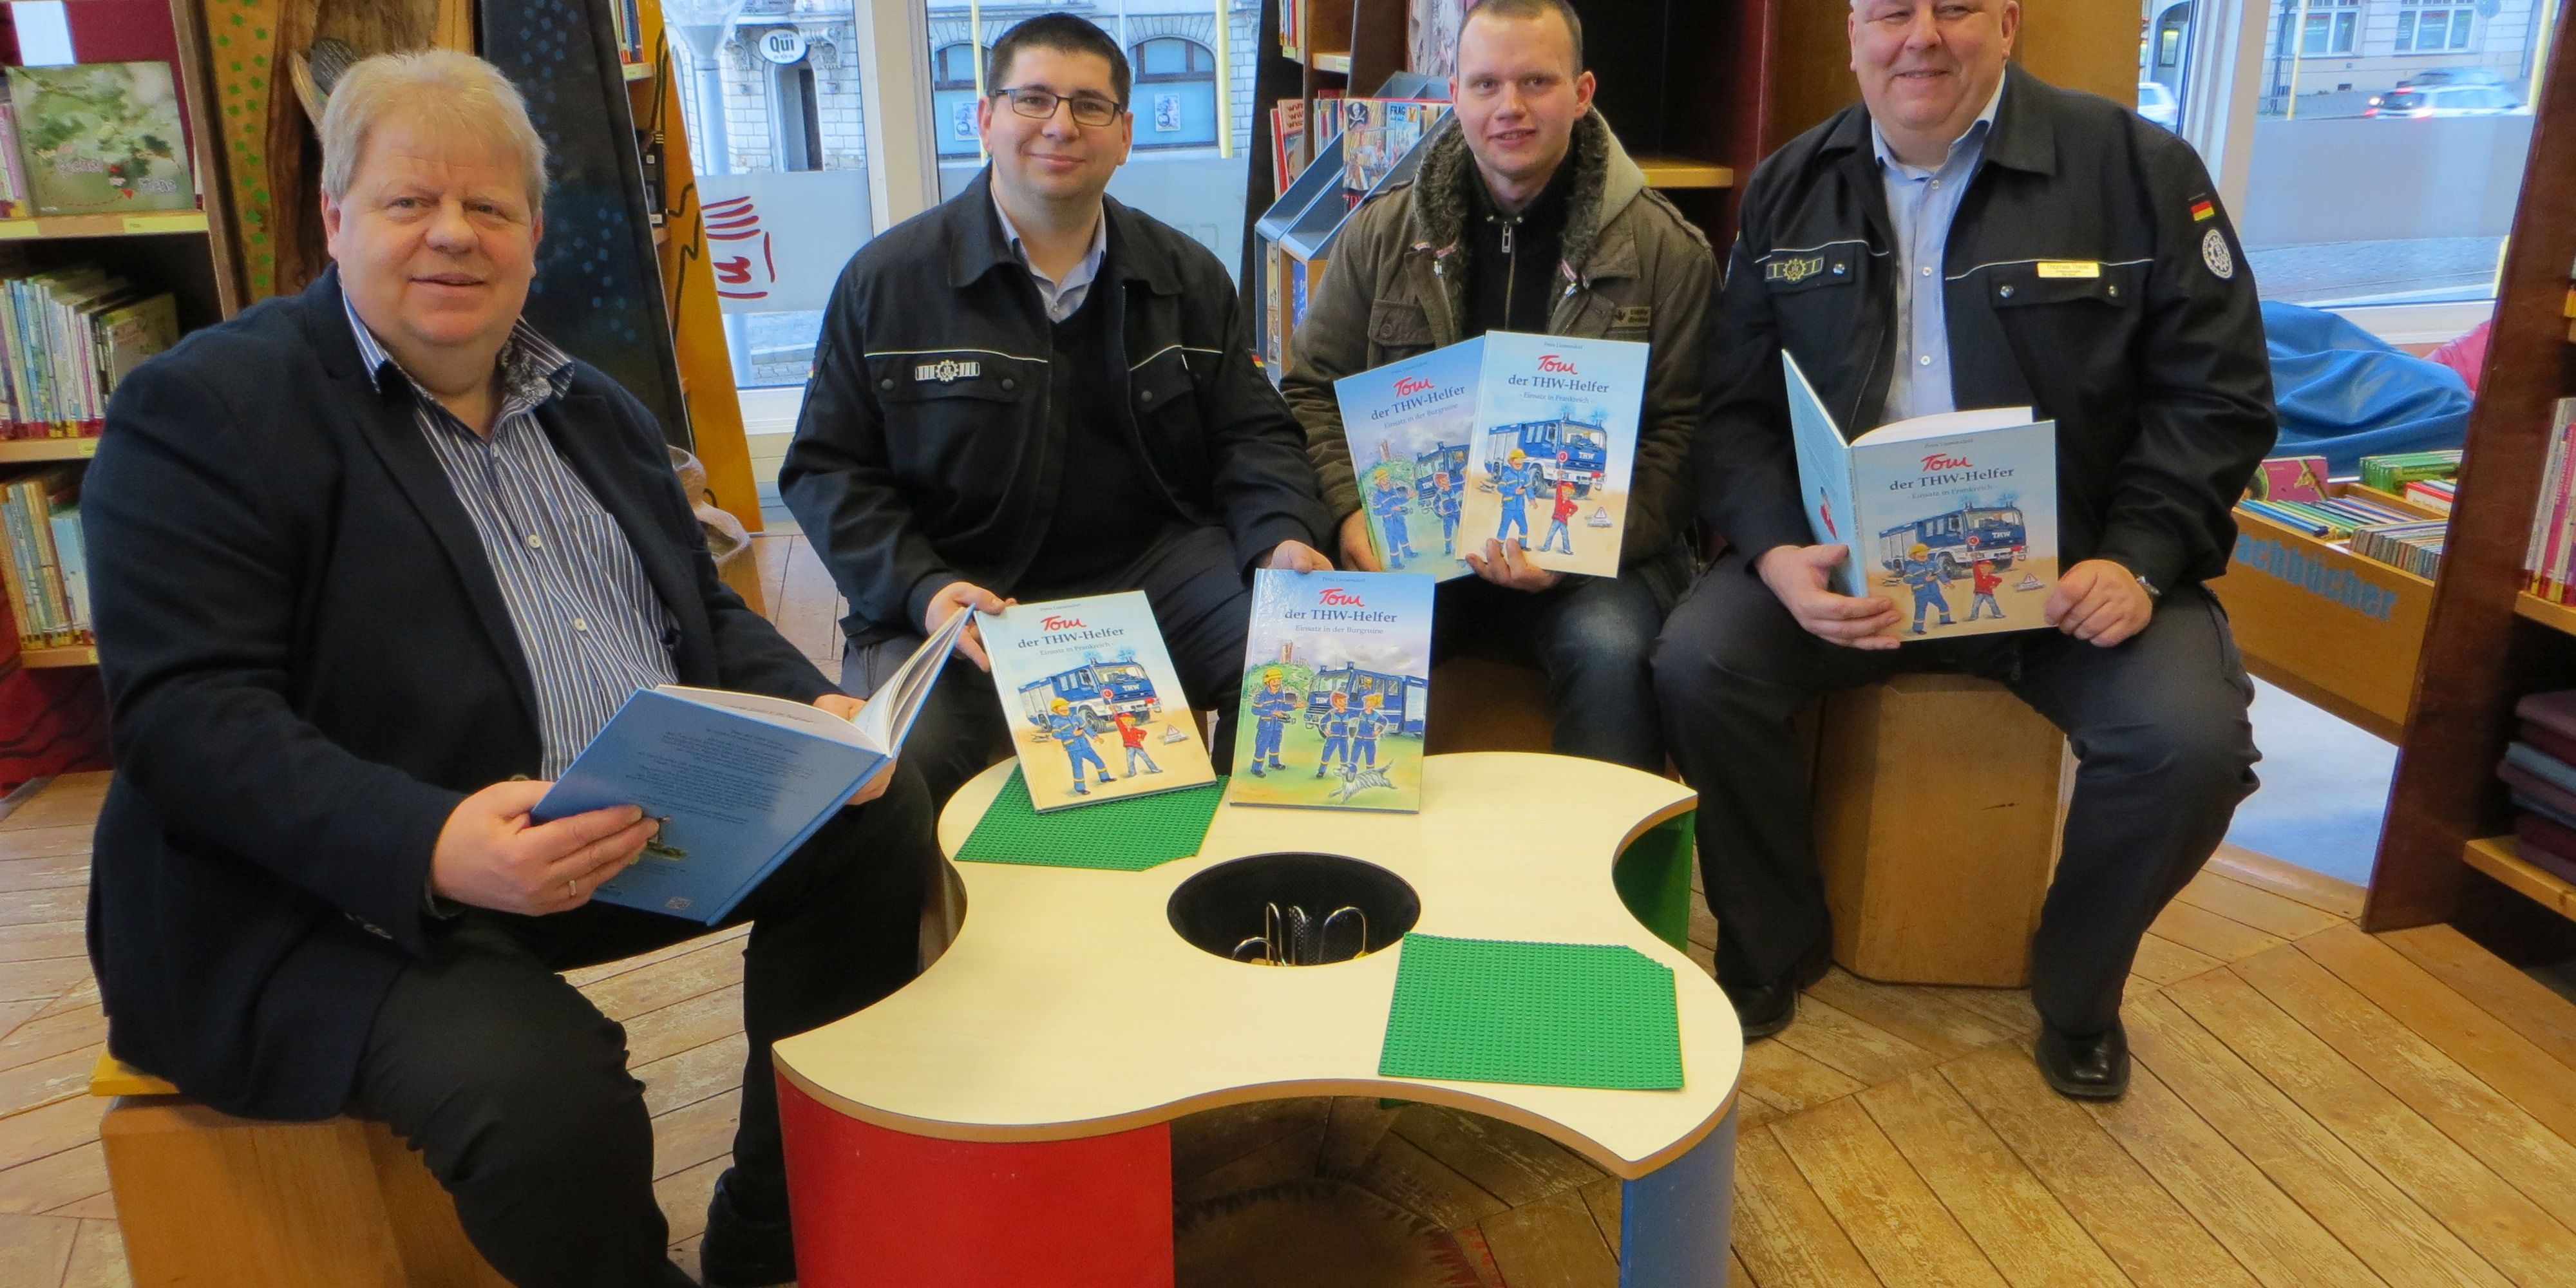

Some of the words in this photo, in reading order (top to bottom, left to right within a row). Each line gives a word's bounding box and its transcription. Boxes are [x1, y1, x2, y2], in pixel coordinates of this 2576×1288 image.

[770, 35, 795, 54] Qui
[1390, 106, 1405, 115] FRAG
[1537, 355, 1578, 375] Tom
[1393, 377, 1435, 398] Tom
[1508, 374, 1528, 386] der
[1531, 376, 1610, 393] THW-Helfer
[1371, 408, 1390, 421] der
[1391, 386, 1466, 414] THW-Helfer
[1524, 392, 1546, 401] Einsatz
[1555, 394, 1590, 404] Frankreich
[1385, 416, 1407, 430] Einsatz
[1416, 412, 1426, 422] der
[1426, 403, 1459, 417] Burgruine
[1920, 453, 1973, 472] Tom
[1889, 480, 1914, 491] der
[1918, 468, 2015, 488] THW-Helfer
[1911, 491, 1940, 500] Einsatz
[1951, 484, 1993, 495] Frankreich
[2231, 533, 2398, 623] achbücher
[1319, 588, 1365, 607] Tom
[1040, 615, 1087, 632] Tom
[1284, 609, 1307, 620] der
[1311, 609, 1398, 623] THW-Helfer
[1018, 638, 1039, 649] der
[1041, 627, 1124, 645] THW-Helfer
[1295, 624, 1322, 632] Einsatz
[1347, 625, 1385, 636] Burgruine
[1075, 641, 1111, 652] Frankreich
